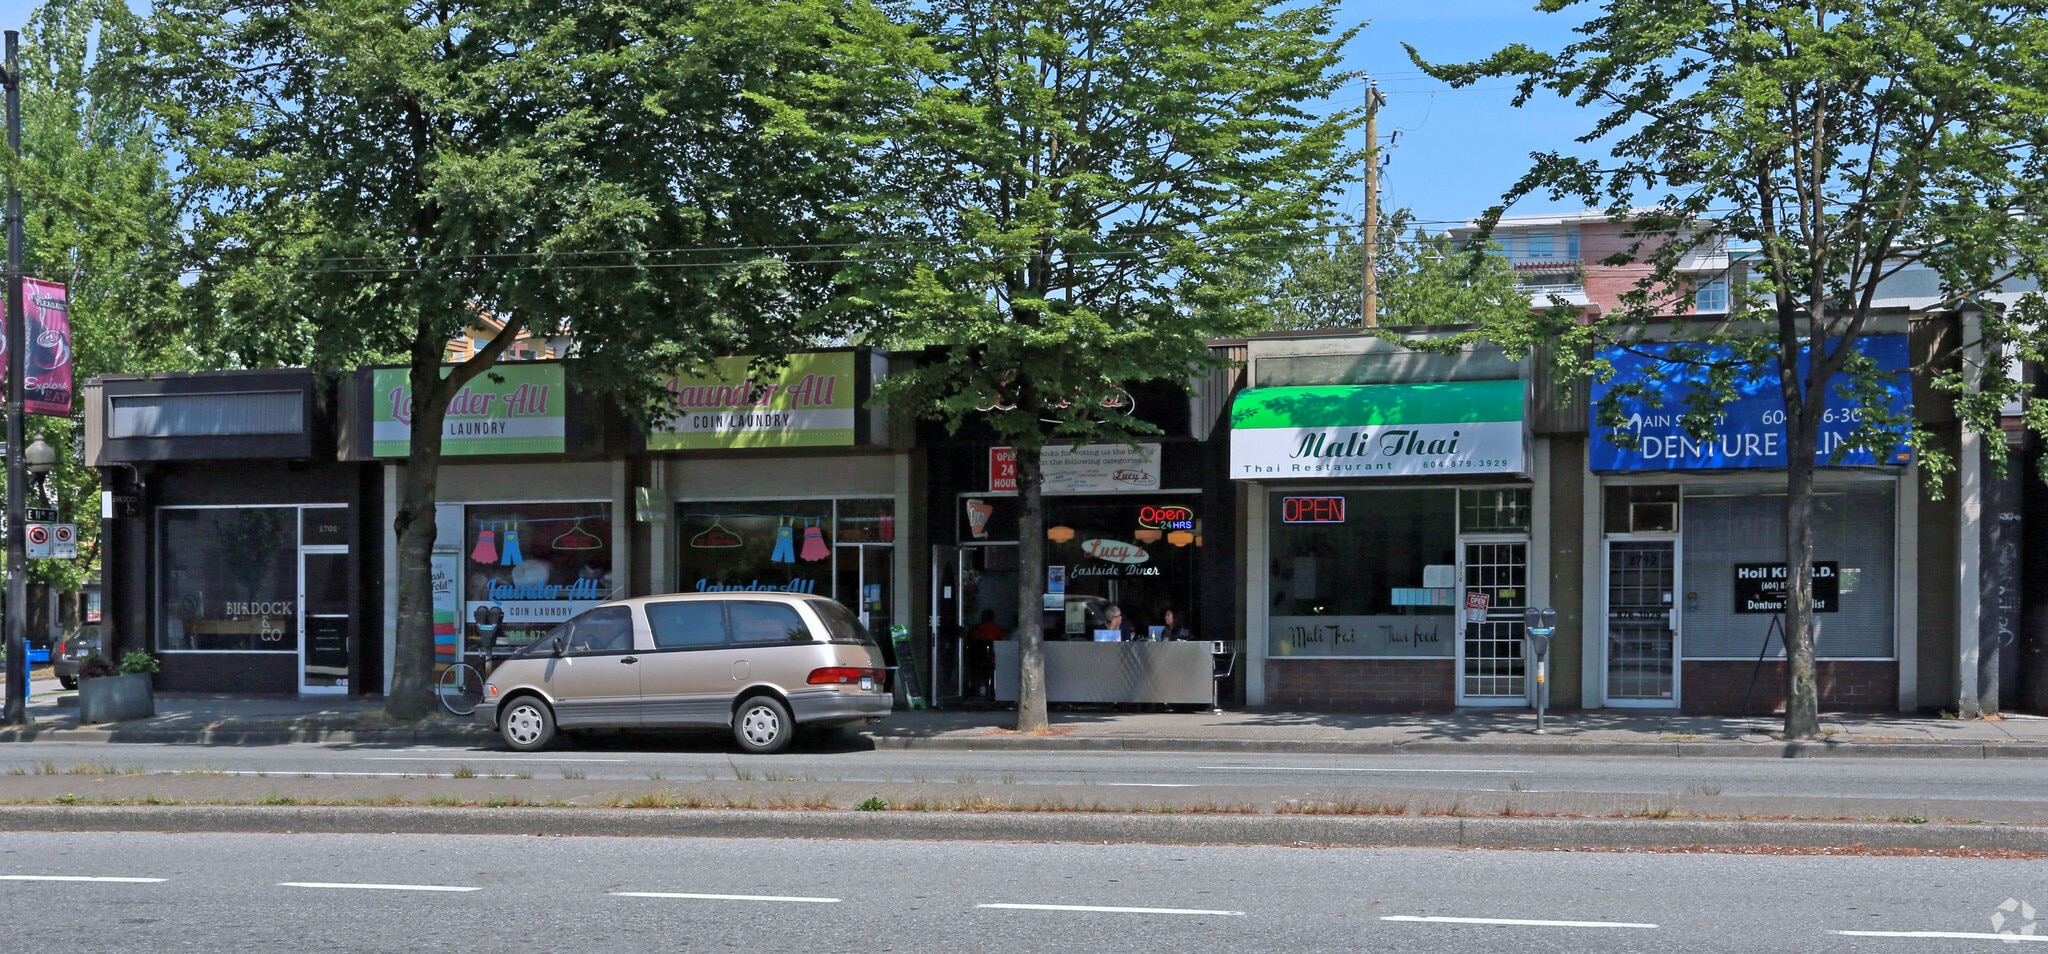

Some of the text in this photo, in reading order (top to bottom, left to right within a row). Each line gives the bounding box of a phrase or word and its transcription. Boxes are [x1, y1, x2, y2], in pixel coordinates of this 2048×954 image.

[24, 377, 68, 394] Explore
[786, 373, 836, 411] All
[44, 391, 67, 403] EAT
[388, 382, 550, 426] Lader All
[694, 413, 789, 428] COIN LAUNDRY
[451, 421, 506, 435] LAUNDRY
[1289, 430, 1461, 459] Mali Thai
[1643, 433, 1778, 458] DENTURE
[1040, 449, 1059, 457] anks
[1064, 458, 1100, 467] following
[1244, 459, 1508, 473] Thai Restaurant 604.879.3929
[1001, 464, 1014, 476] 24
[1113, 469, 1149, 482] Lucy's
[994, 478, 1017, 487] HOUR
[28, 509, 34, 519] E
[1141, 506, 1185, 523] Open
[1284, 498, 1343, 521] OPEN
[1160, 520, 1192, 529] 24 HRS
[1084, 539, 1147, 561] Lucy's
[1071, 564, 1160, 578] Eastside Diner
[1738, 567, 1767, 578] Hoil
[1772, 567, 1787, 578] Ki
[487, 577, 598, 606] Launder All
[1761, 581, 1779, 591] (604)
[1470, 597, 1486, 605] OPEN
[1747, 600, 1782, 610] Denture
[226, 602, 293, 615] BURDOCK
[510, 607, 573, 616] COIN LAUNDRY
[262, 616, 271, 628] &
[1289, 624, 1323, 648] Mali
